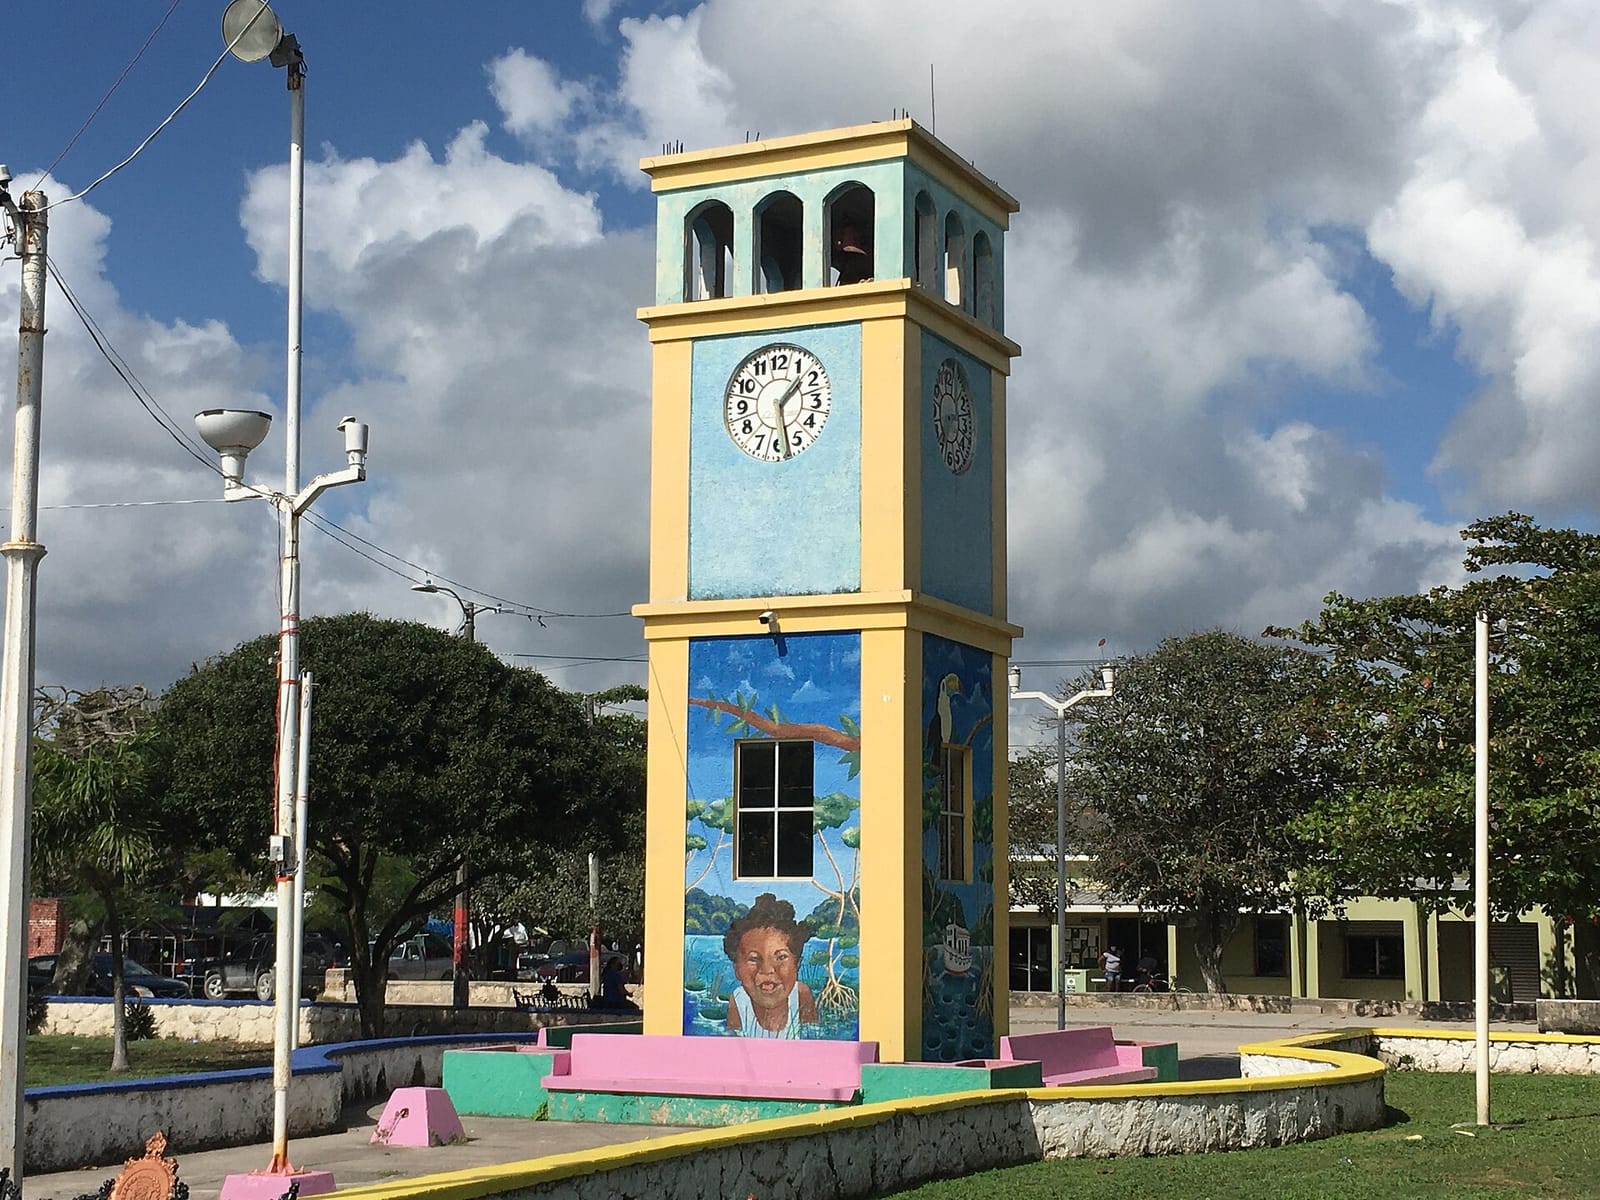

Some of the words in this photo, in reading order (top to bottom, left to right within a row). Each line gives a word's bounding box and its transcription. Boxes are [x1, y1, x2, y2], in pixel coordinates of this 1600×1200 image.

[753, 360, 766, 376] 11
[771, 354, 788, 370] 12
[795, 358, 801, 374] 1
[736, 379, 755, 394] 10
[808, 371, 819, 387] 2
[737, 400, 748, 415] 9
[810, 393, 822, 409] 3
[742, 419, 752, 434] 8
[803, 413, 816, 428] 4
[962, 418, 967, 433] 3
[755, 434, 766, 450] 7
[792, 431, 803, 446] 5
[947, 451, 952, 466] 6
